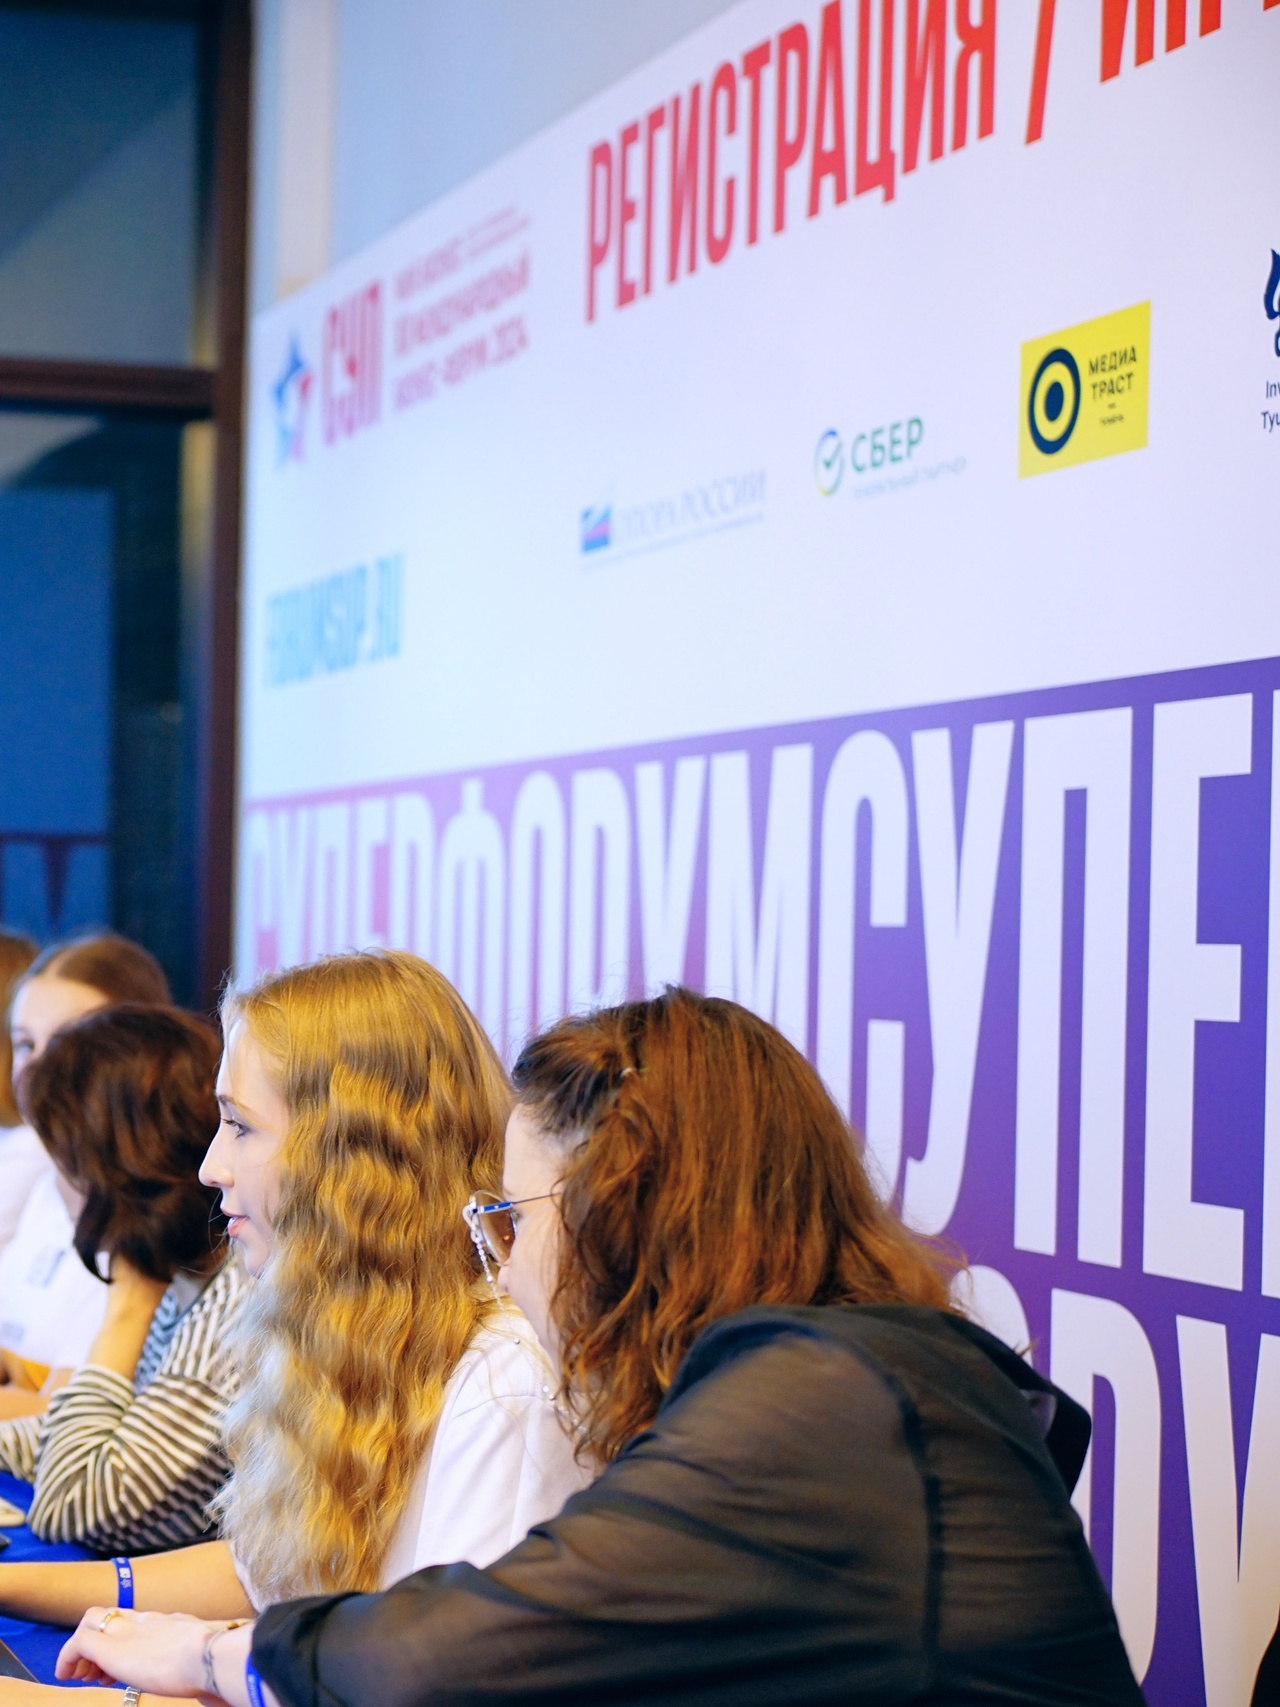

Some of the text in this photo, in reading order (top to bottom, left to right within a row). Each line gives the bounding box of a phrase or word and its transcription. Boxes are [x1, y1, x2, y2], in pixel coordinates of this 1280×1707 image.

[586, 0, 997, 324] РЕГИСТРАЦИЯ
[1088, 345, 1138, 377] МЕДИА
[1091, 371, 1134, 401] ТРАСТ
[851, 416, 924, 472] СБЕР
